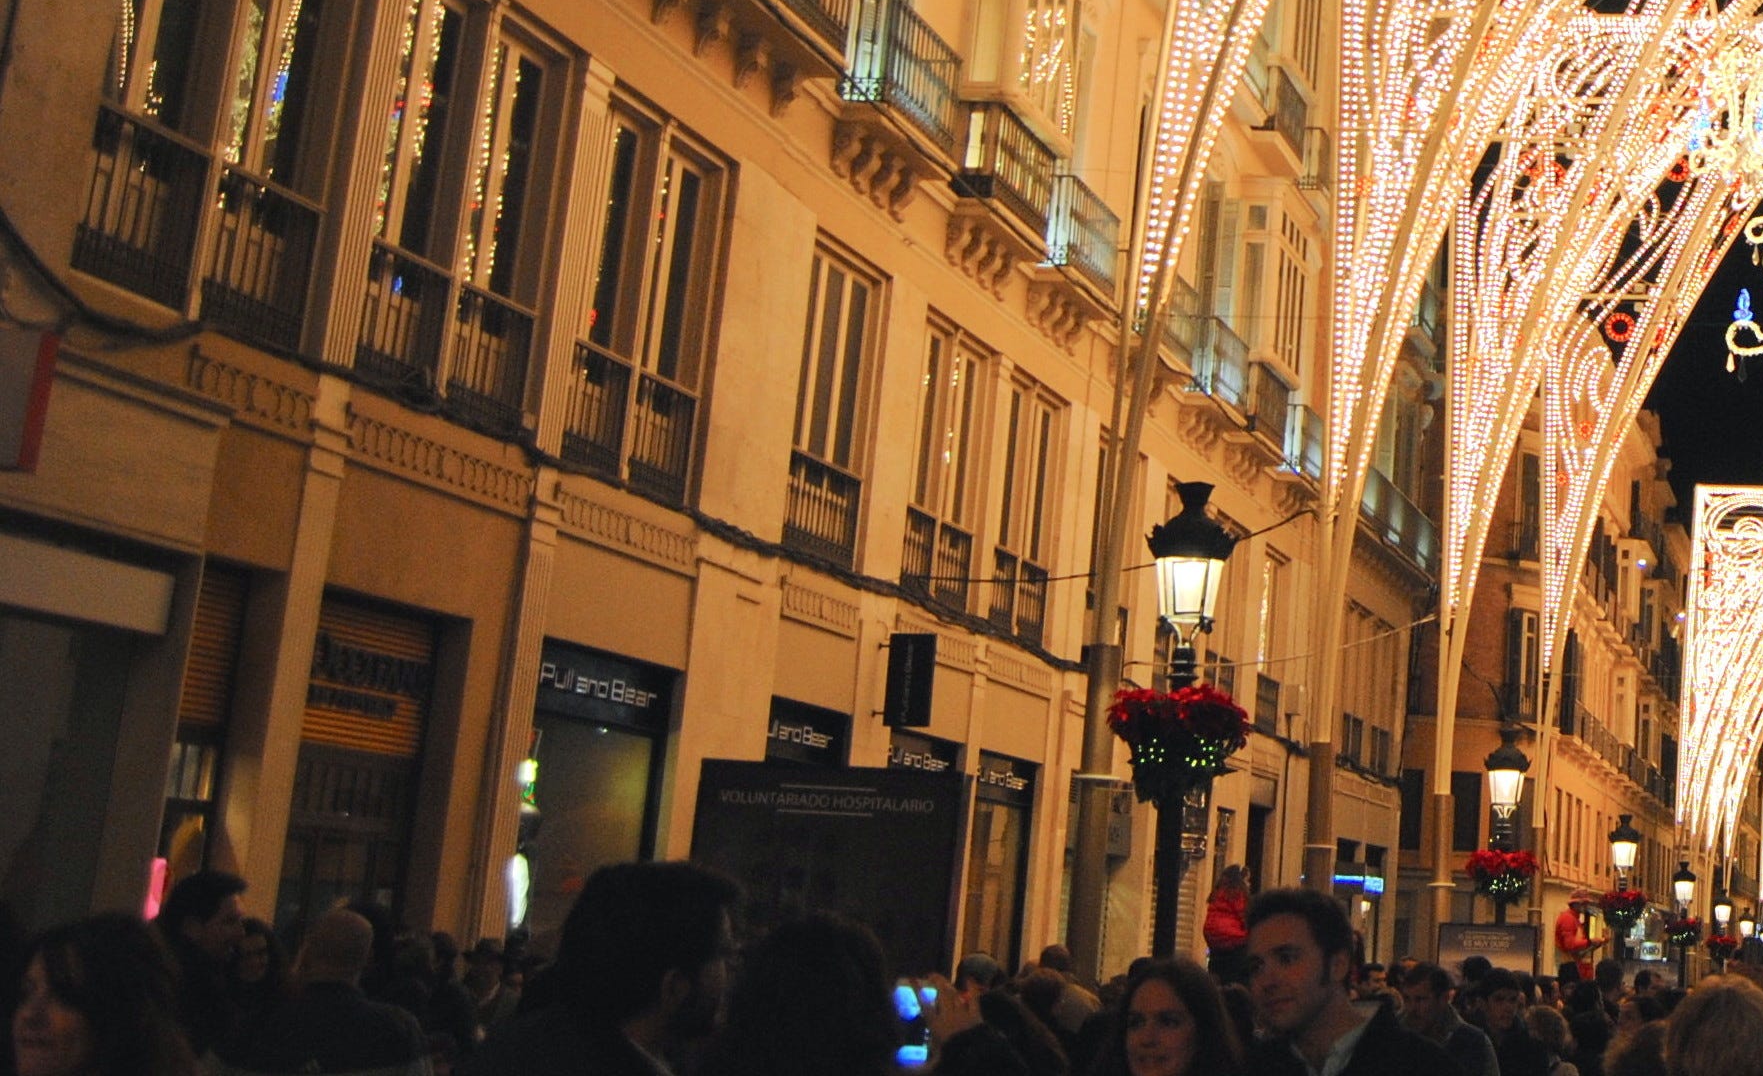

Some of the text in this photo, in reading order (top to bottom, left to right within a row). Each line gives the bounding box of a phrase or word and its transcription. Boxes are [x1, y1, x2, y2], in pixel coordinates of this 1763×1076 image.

[540, 662, 574, 690] Pull
[611, 678, 657, 709] Bear
[803, 726, 834, 748] Bear
[719, 789, 934, 813] VOLUNTARIADO HOSPITALARIO
